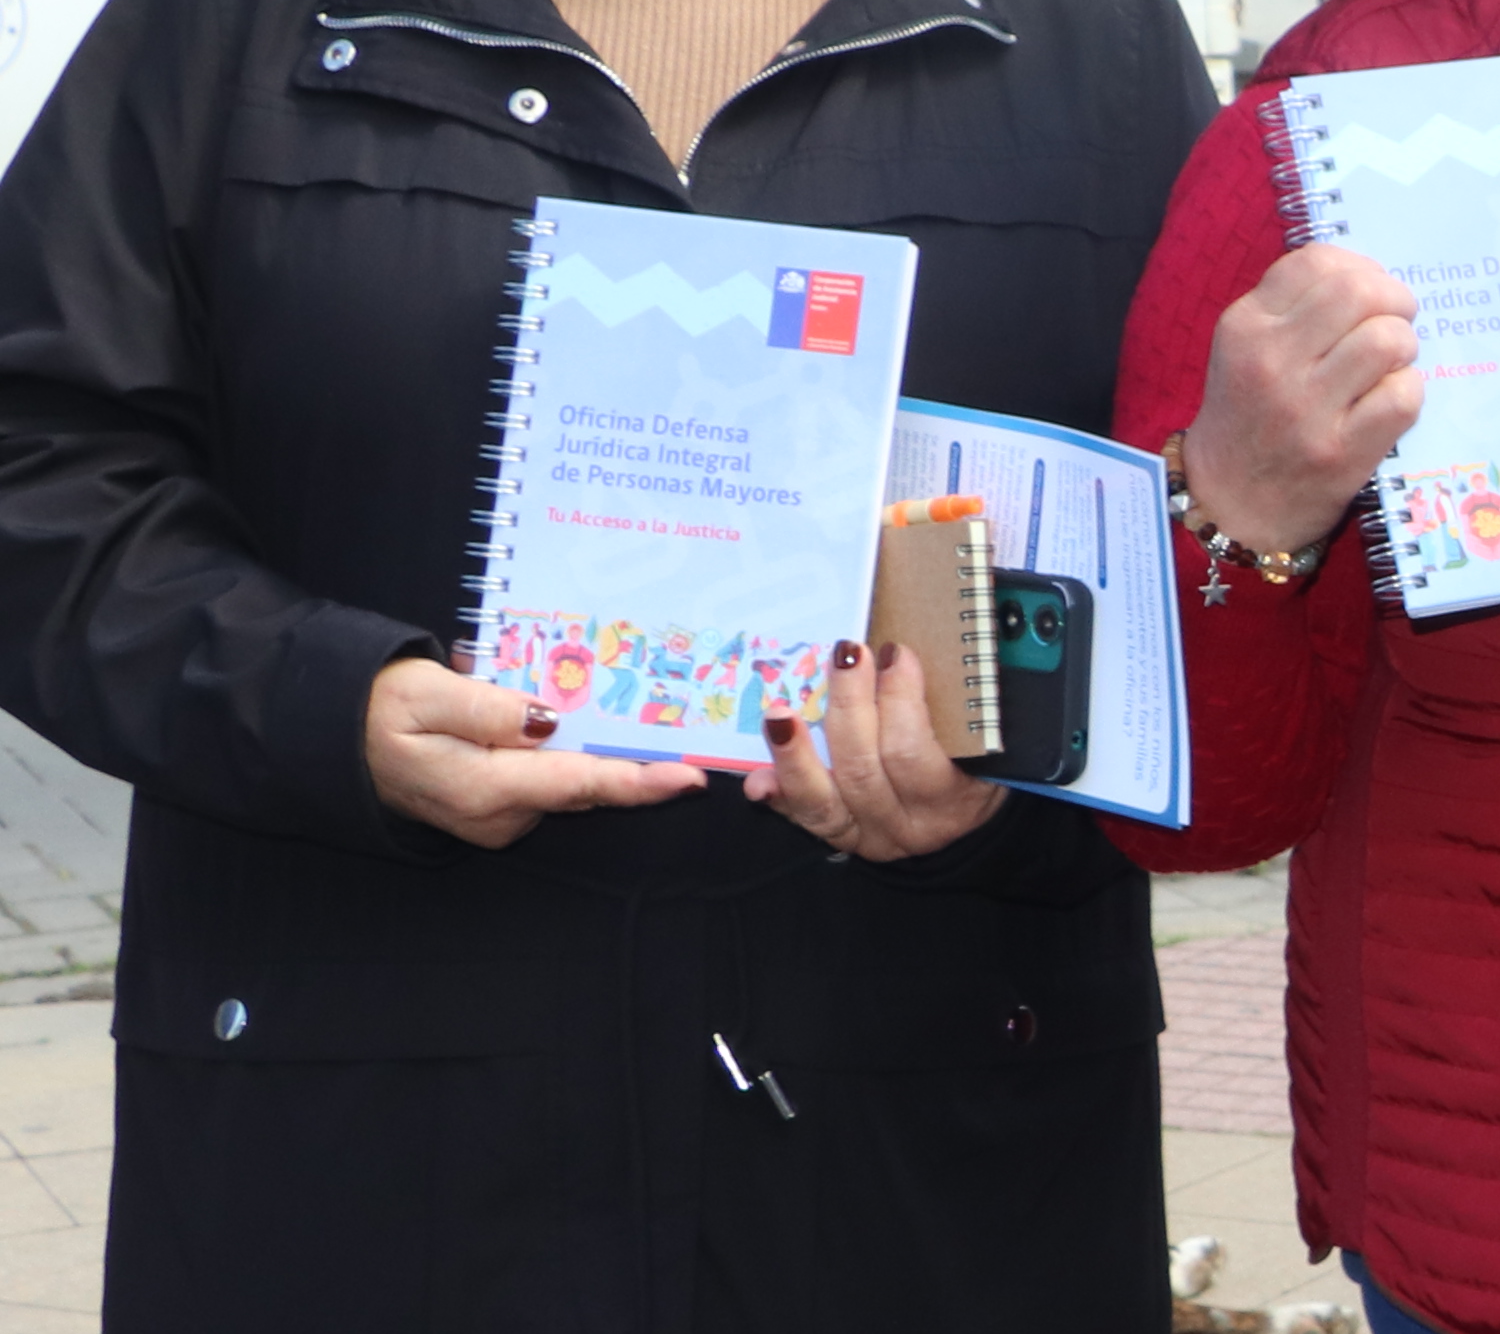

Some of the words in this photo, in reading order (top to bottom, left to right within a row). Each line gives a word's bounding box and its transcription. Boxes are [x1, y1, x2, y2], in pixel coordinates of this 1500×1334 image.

[1416, 288, 1491, 313] rídica
[1415, 324, 1429, 339] e
[1434, 361, 1498, 379] Acceso
[559, 404, 645, 432] Oficina
[652, 414, 750, 444] Defensa
[554, 433, 650, 462] Jurídica
[657, 444, 751, 474] Integral
[551, 461, 580, 482] de
[587, 464, 693, 495] Personas
[700, 476, 802, 506] Mayores
[548, 506, 565, 523] Tu
[570, 510, 632, 530] Acceso
[637, 520, 647, 531] a
[652, 519, 667, 533] la
[674, 521, 741, 541] Justicia
